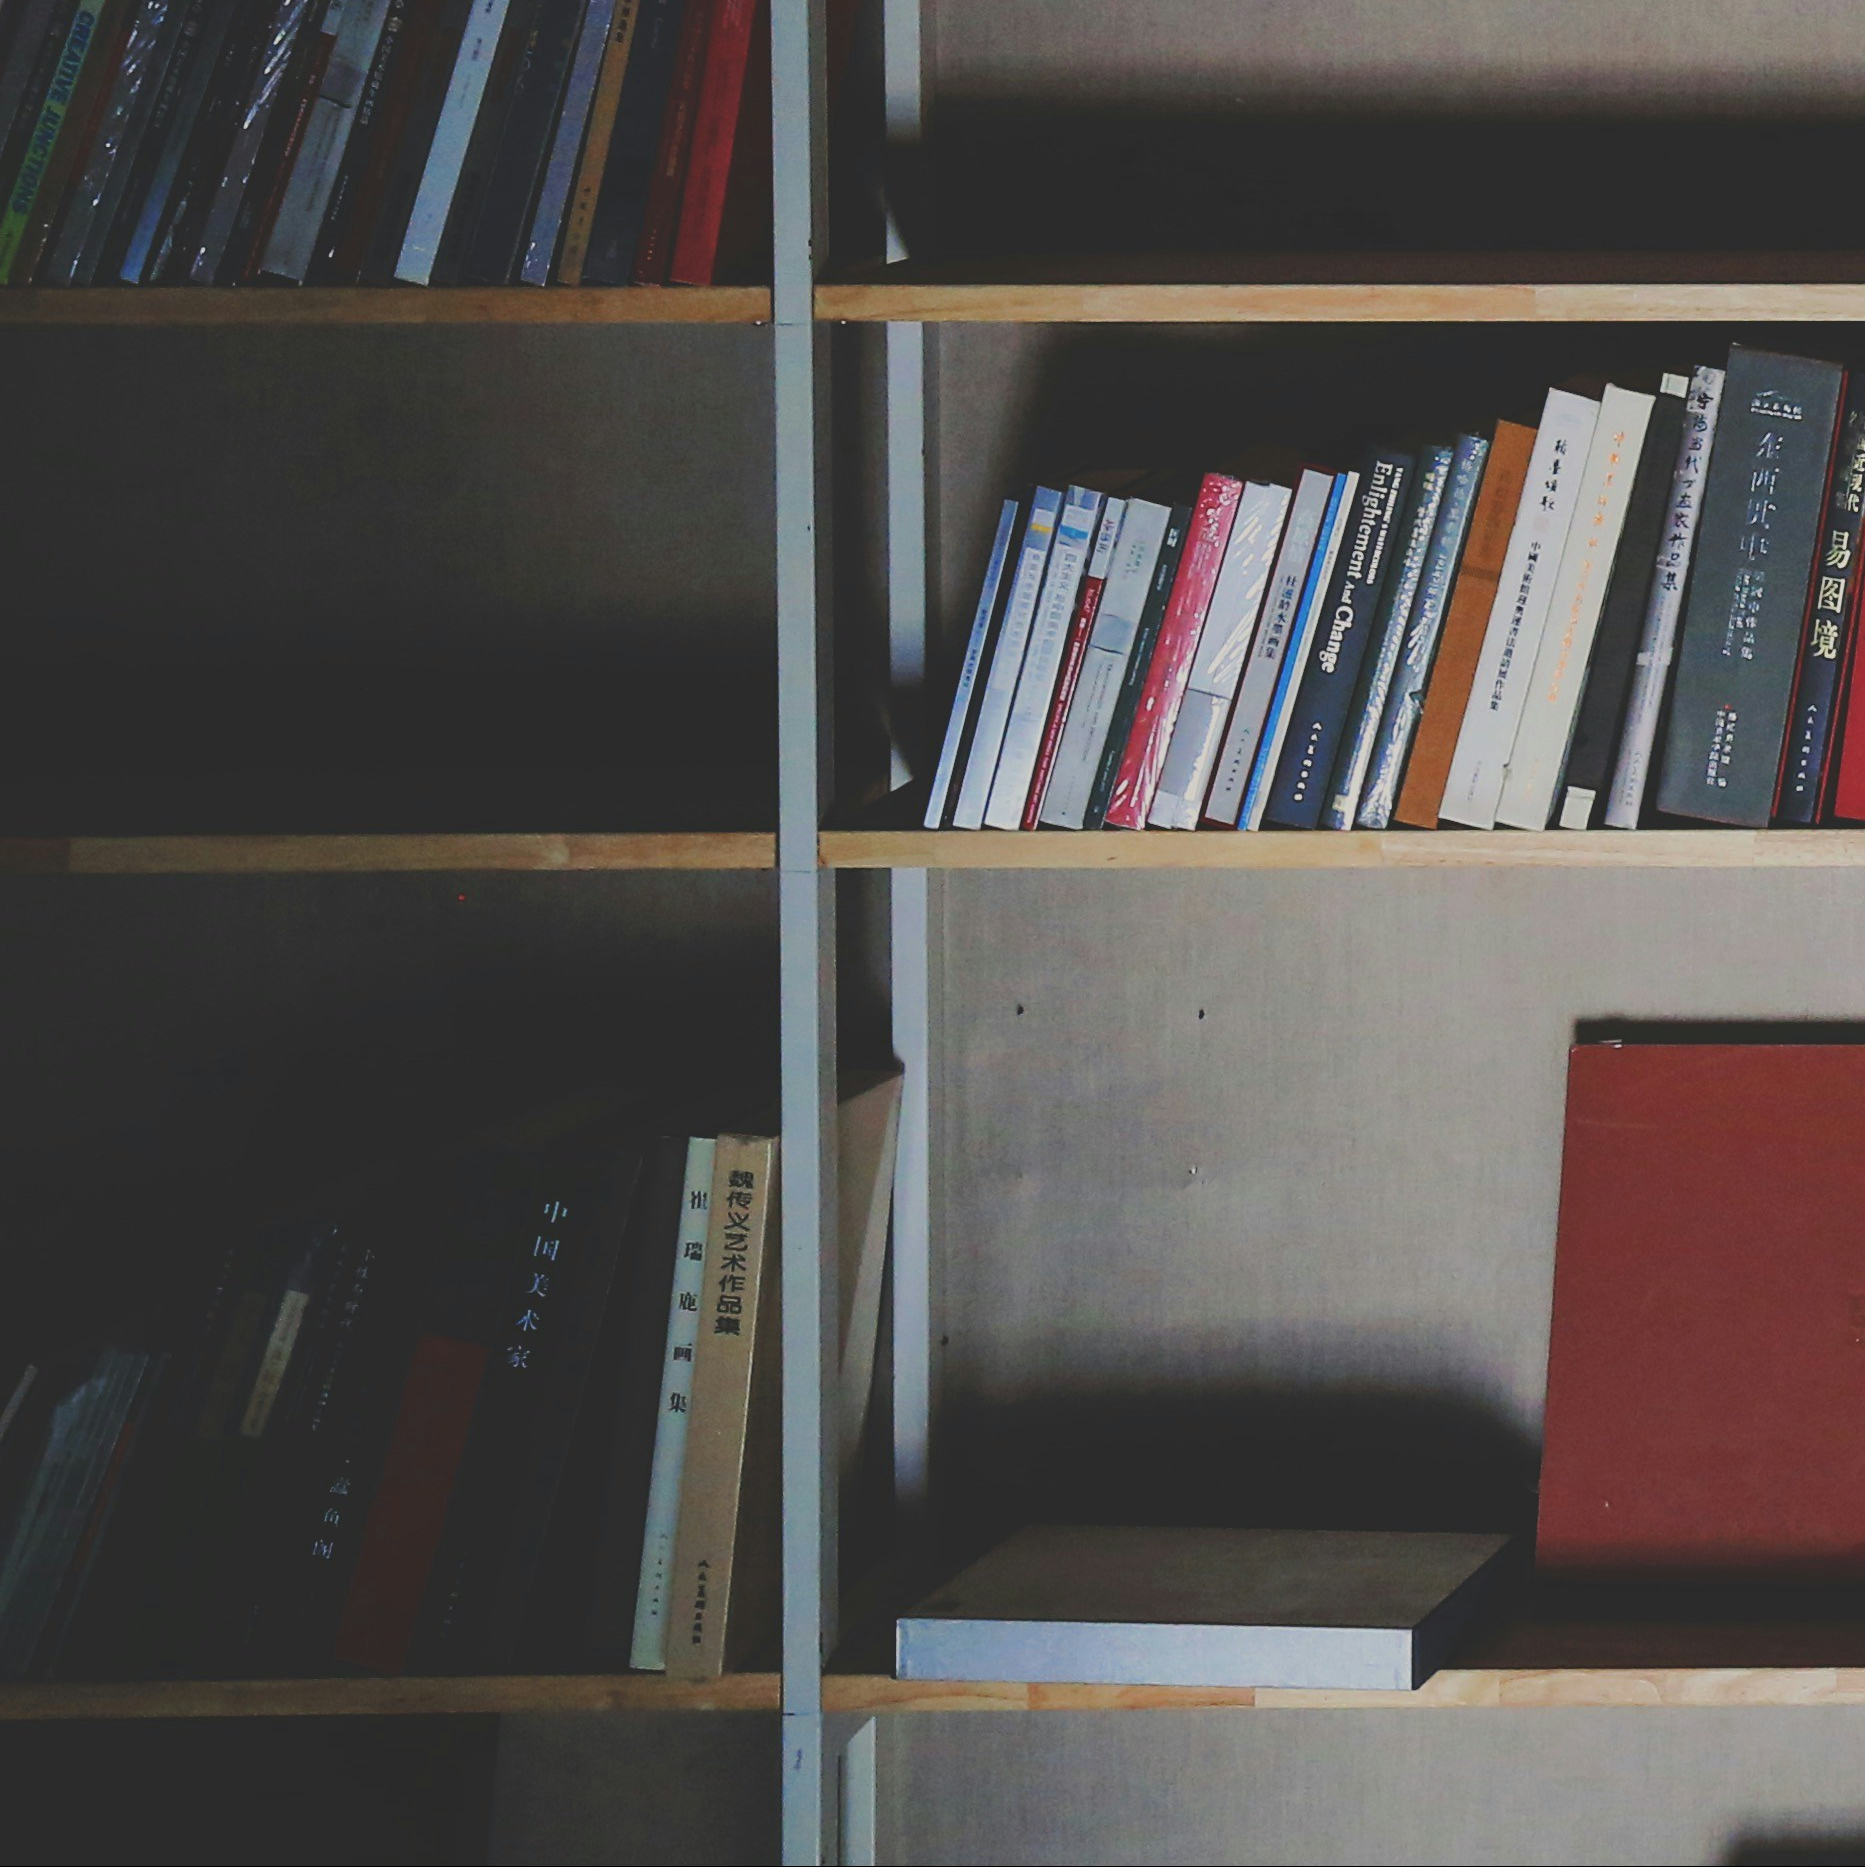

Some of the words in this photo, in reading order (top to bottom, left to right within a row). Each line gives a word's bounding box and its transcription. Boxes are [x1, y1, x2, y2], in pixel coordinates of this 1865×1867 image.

[1320, 604, 1355, 675] Change
[1809, 529, 1852, 660] 易图境
[713, 1169, 756, 1337] 魏传义艺术作品集
